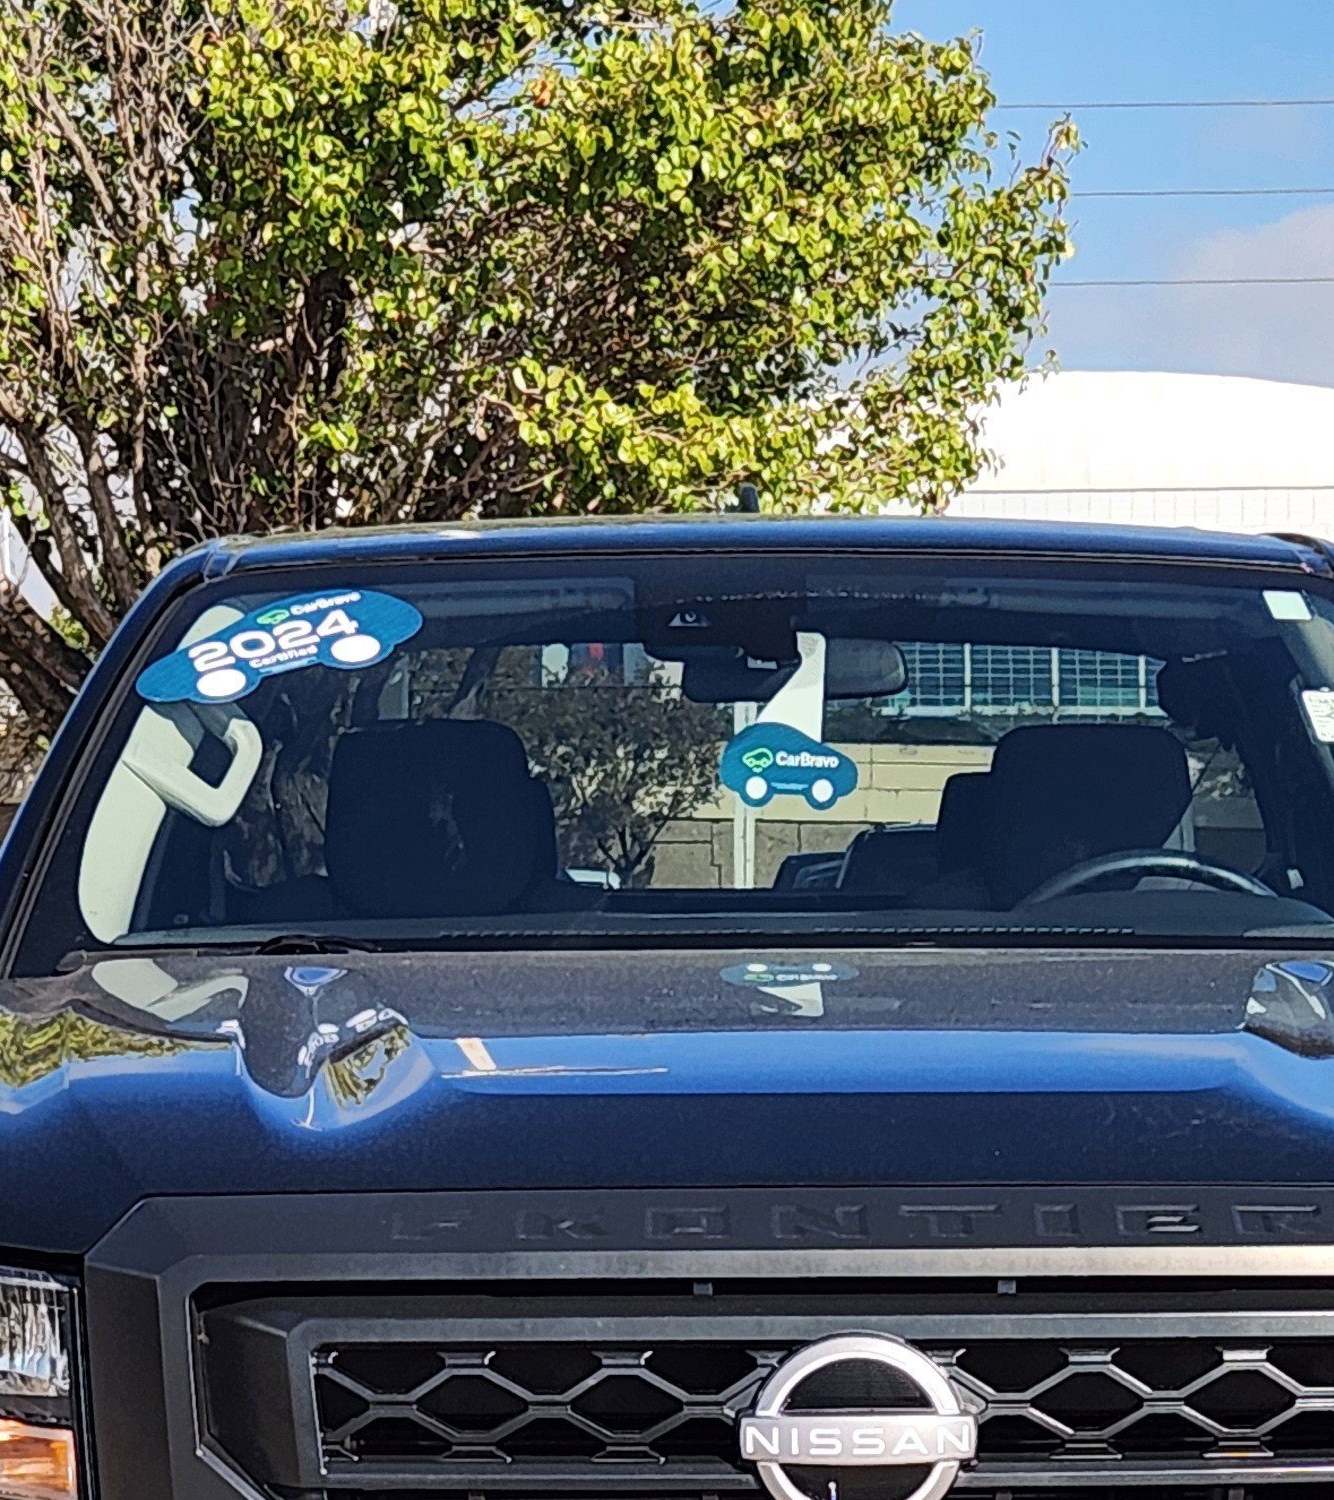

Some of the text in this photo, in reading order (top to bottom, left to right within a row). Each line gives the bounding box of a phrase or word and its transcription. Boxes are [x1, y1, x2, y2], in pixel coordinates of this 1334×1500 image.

[187, 608, 360, 674] 2024
[775, 750, 839, 768] CarBravo
[390, 1203, 1325, 1242] FRONTIER
[745, 1424, 972, 1456] NISSAN
